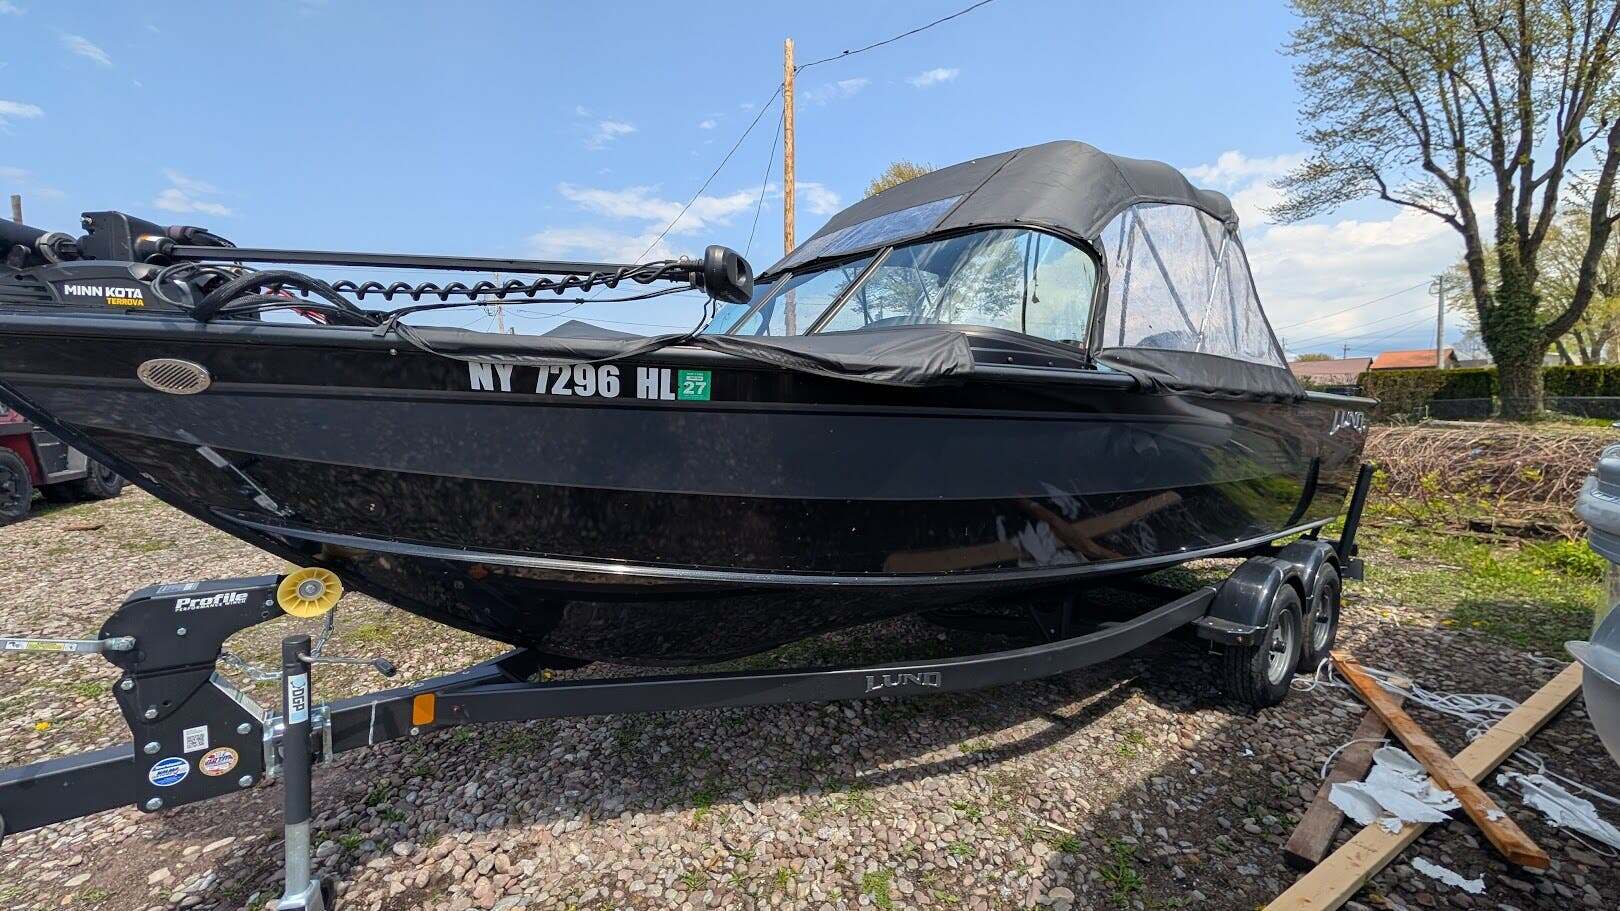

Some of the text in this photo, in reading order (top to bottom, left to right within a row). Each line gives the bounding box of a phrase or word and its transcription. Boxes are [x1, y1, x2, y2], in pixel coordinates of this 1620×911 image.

[64, 285, 143, 298] MINN KOTA
[106, 297, 144, 306] TERROVA
[468, 361, 676, 400] NY 7296 HL
[683, 381, 707, 395] 27
[175, 592, 249, 610] Profile
[865, 671, 942, 693] LUND
[292, 687, 305, 711] DGP
